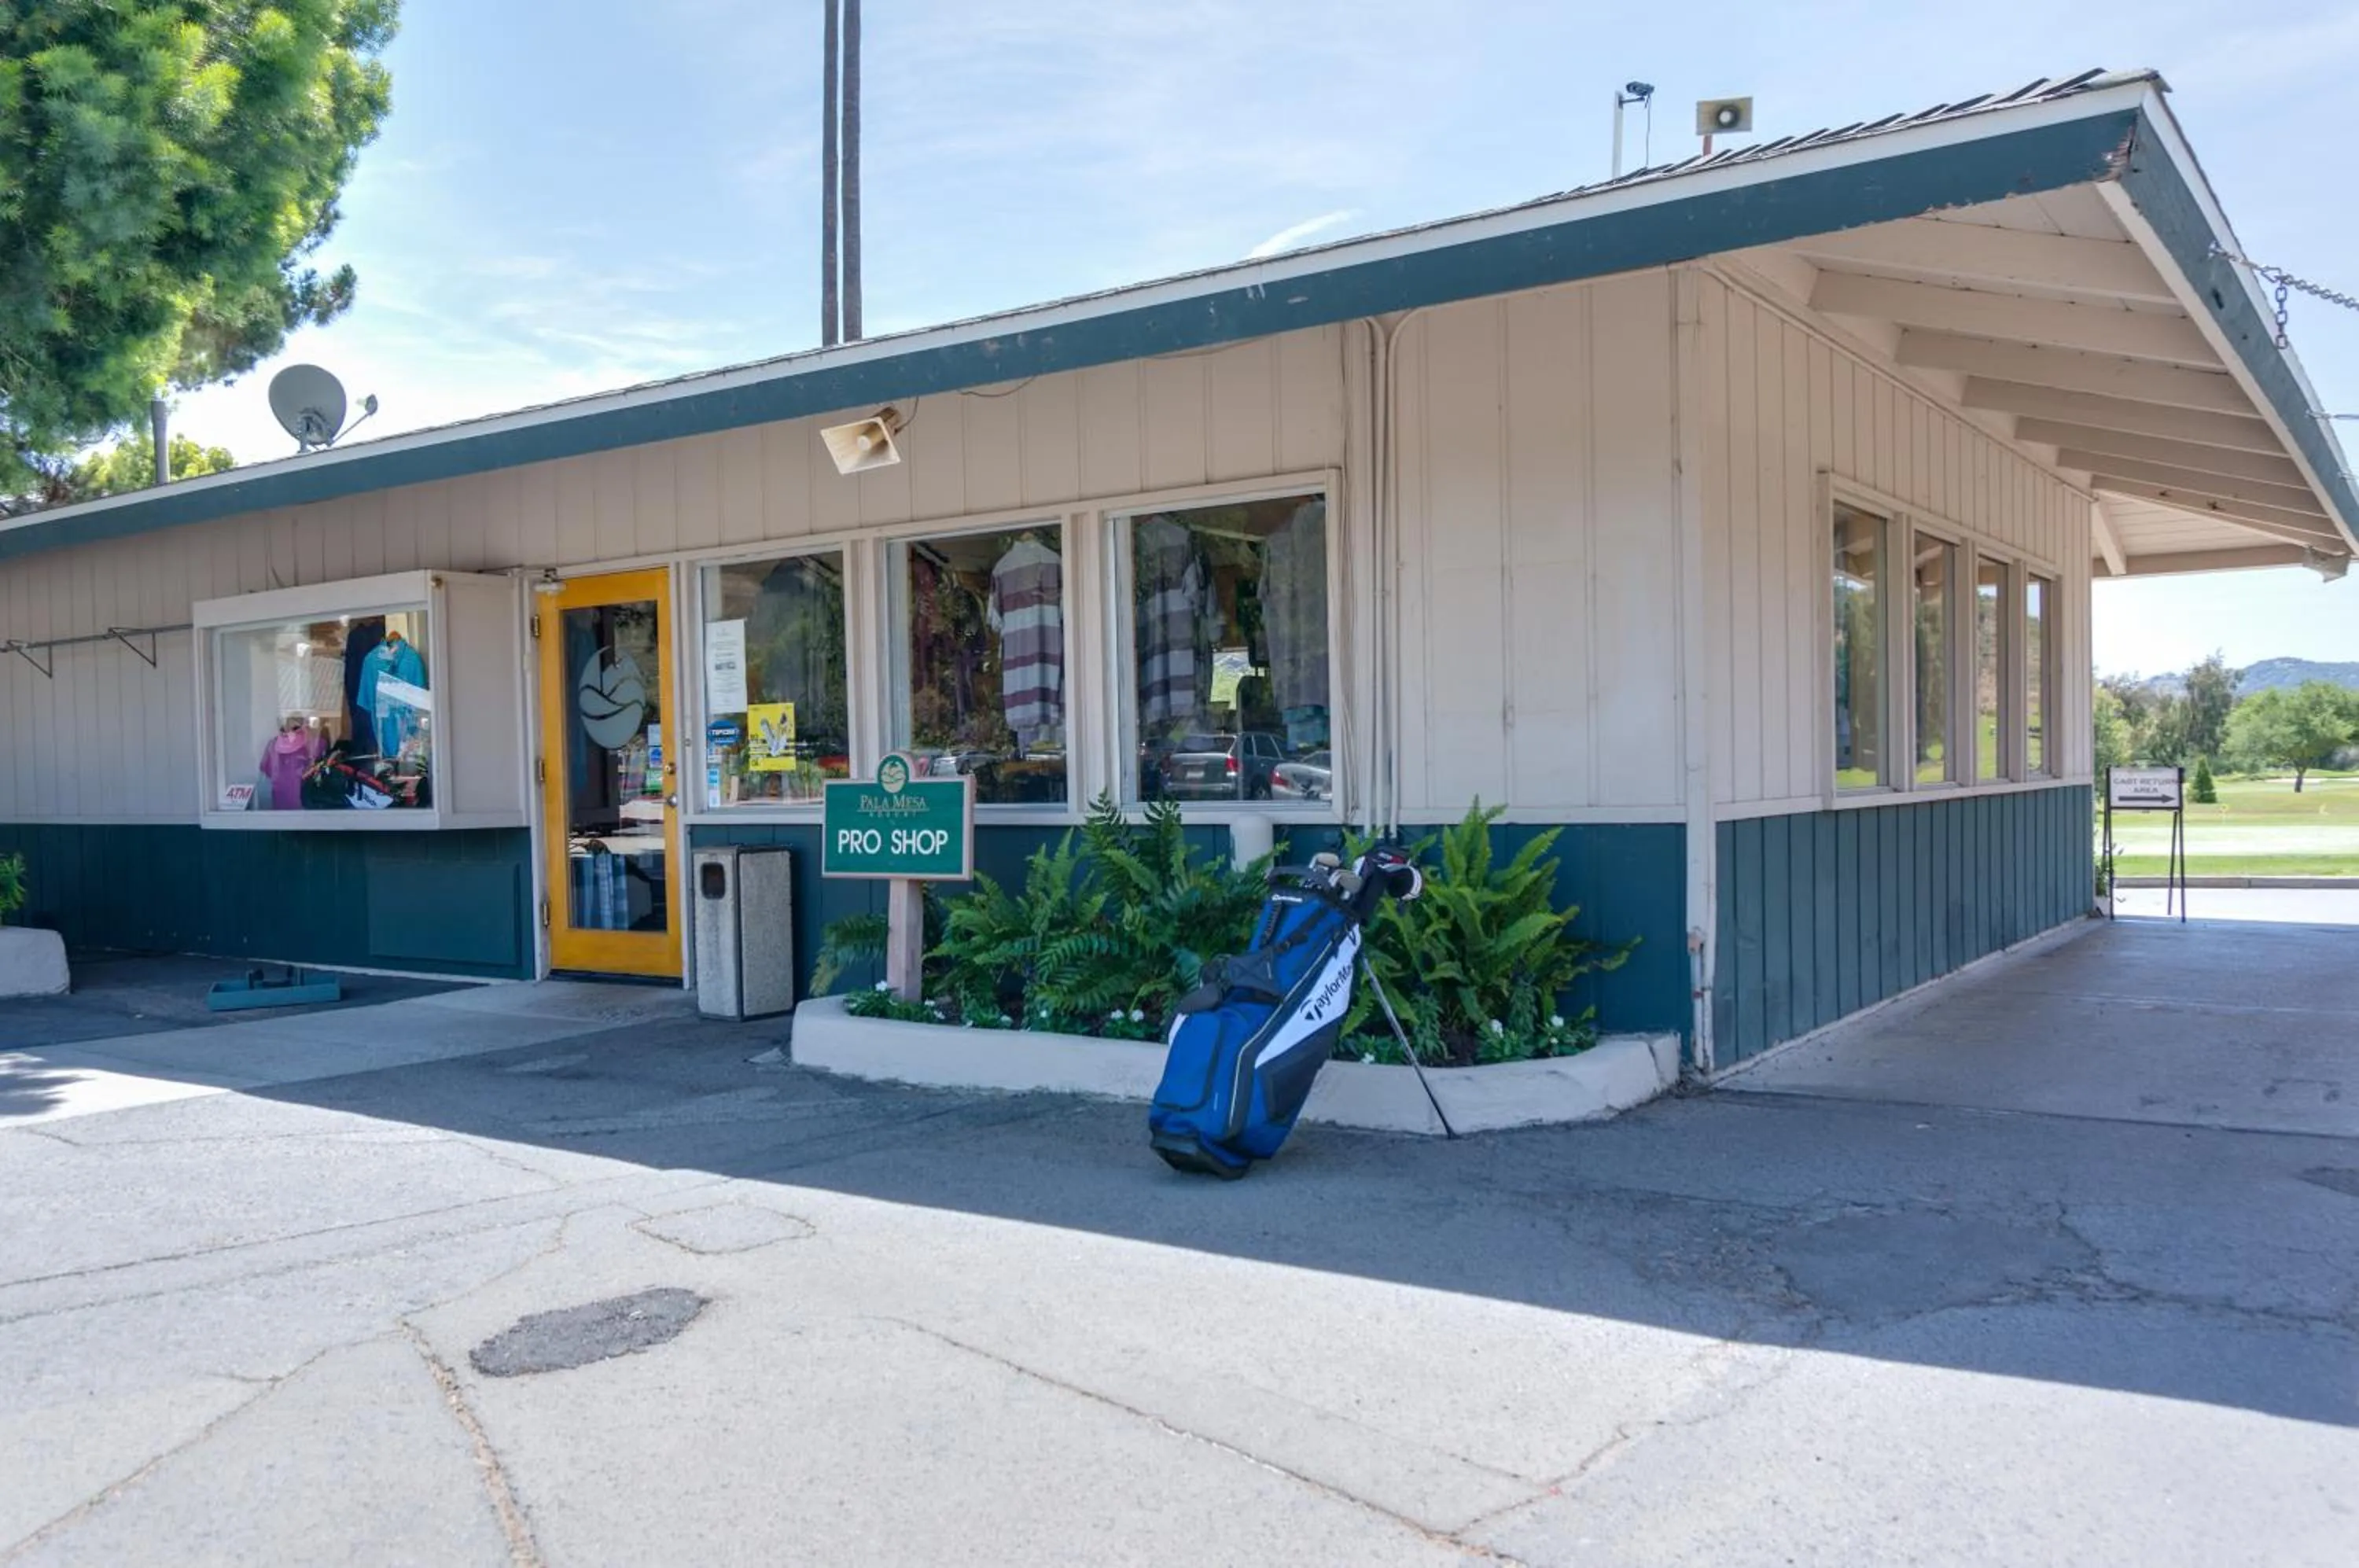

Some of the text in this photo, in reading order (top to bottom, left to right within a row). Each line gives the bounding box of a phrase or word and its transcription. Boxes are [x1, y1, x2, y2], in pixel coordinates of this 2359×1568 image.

[226, 787, 252, 800] ATM
[859, 793, 927, 811] PALA MESA
[838, 829, 948, 855] PRO SHOP
